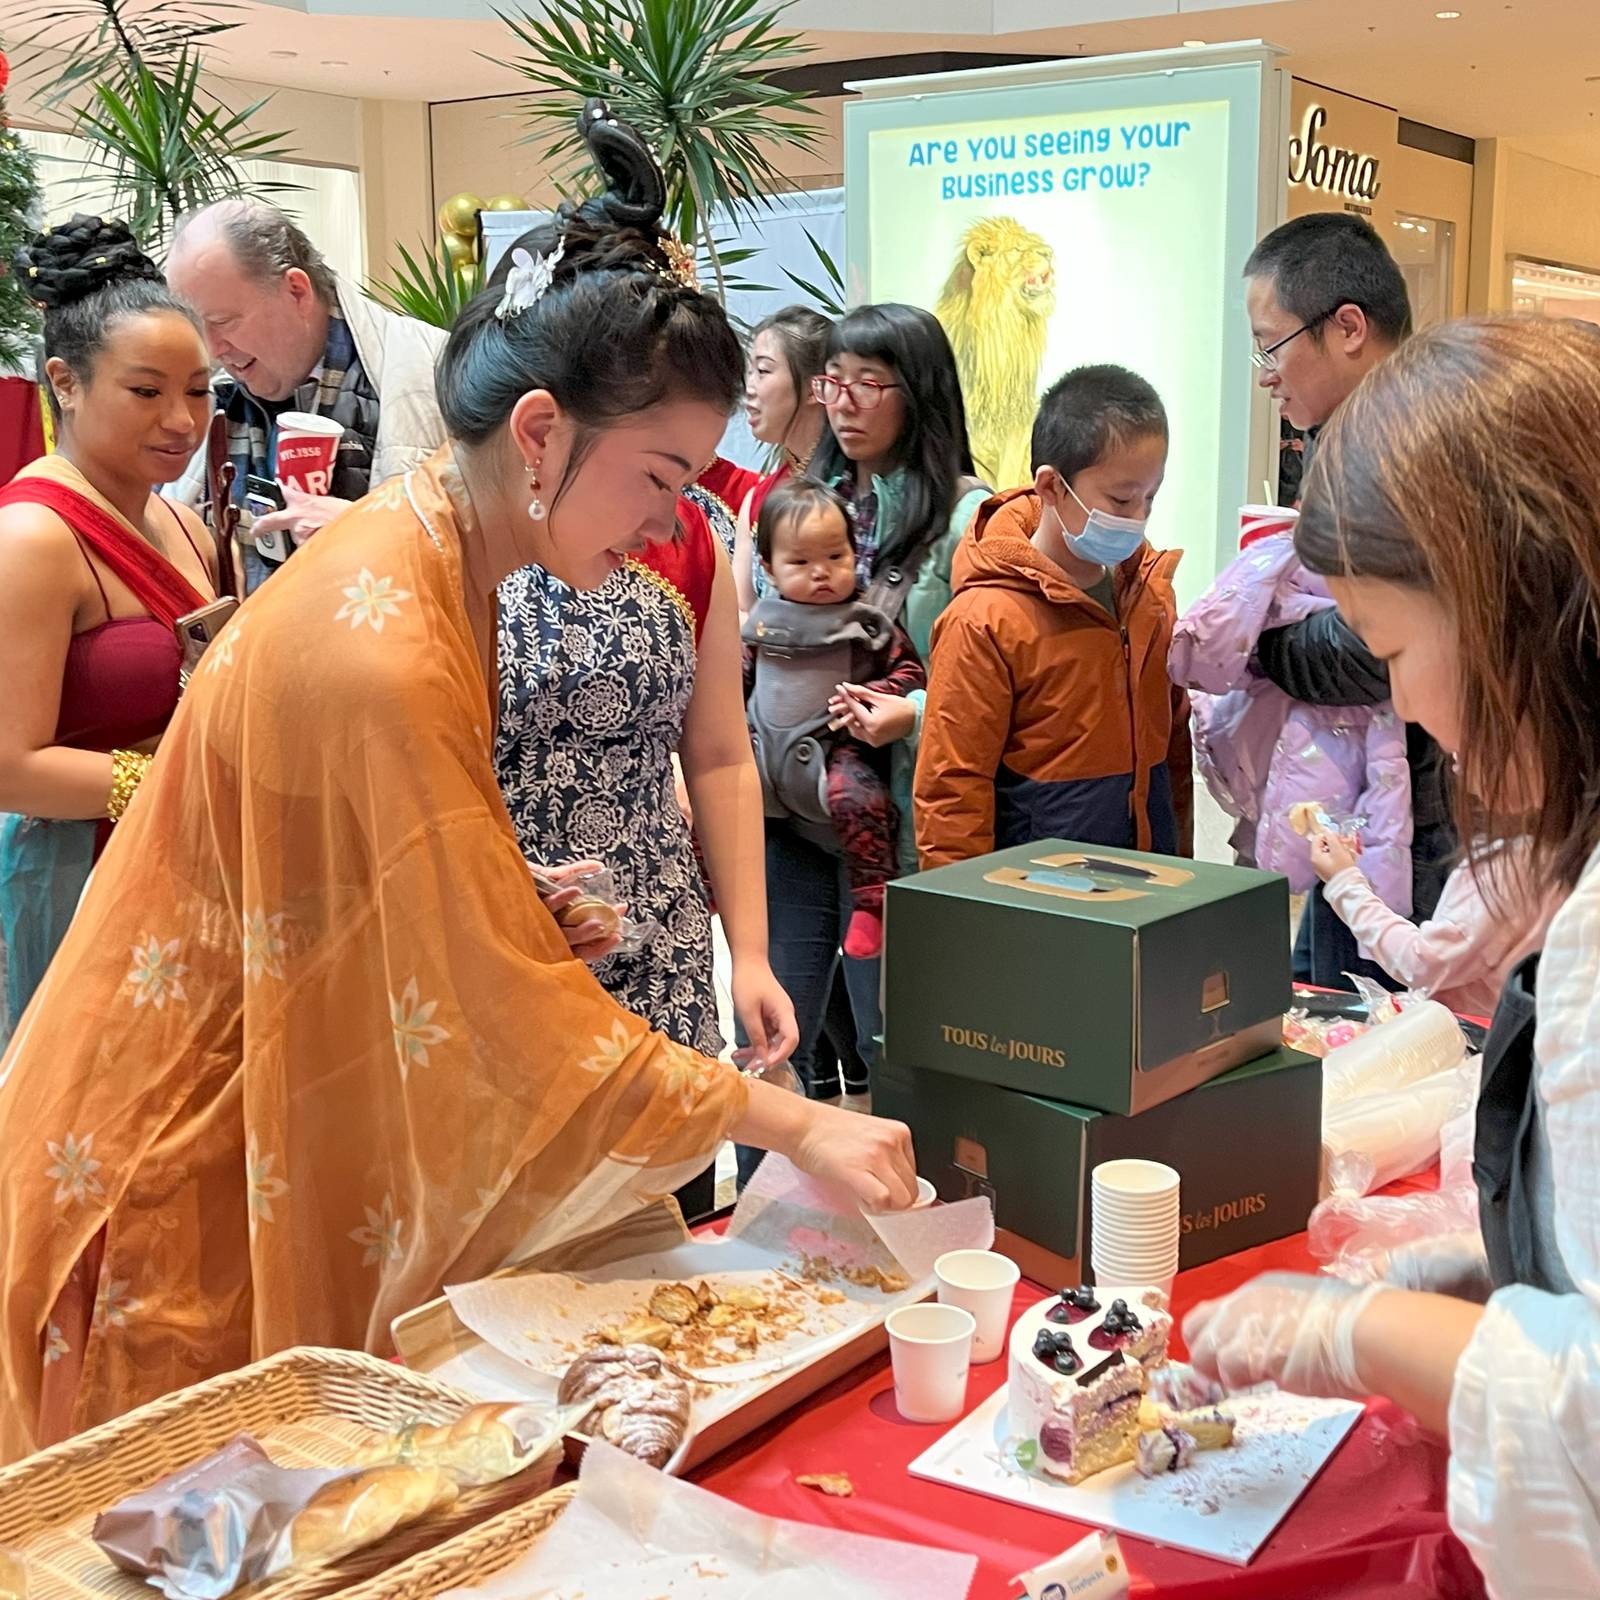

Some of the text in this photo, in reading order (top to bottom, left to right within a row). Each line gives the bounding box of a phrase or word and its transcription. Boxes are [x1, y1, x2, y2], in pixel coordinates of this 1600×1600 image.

[909, 141, 958, 167] Are
[1288, 106, 1381, 200] Soma
[942, 162, 1151, 200] Business Grow?
[941, 1024, 1066, 1068] TOUS les JOURS
[1214, 1193, 1266, 1230] JOURS
